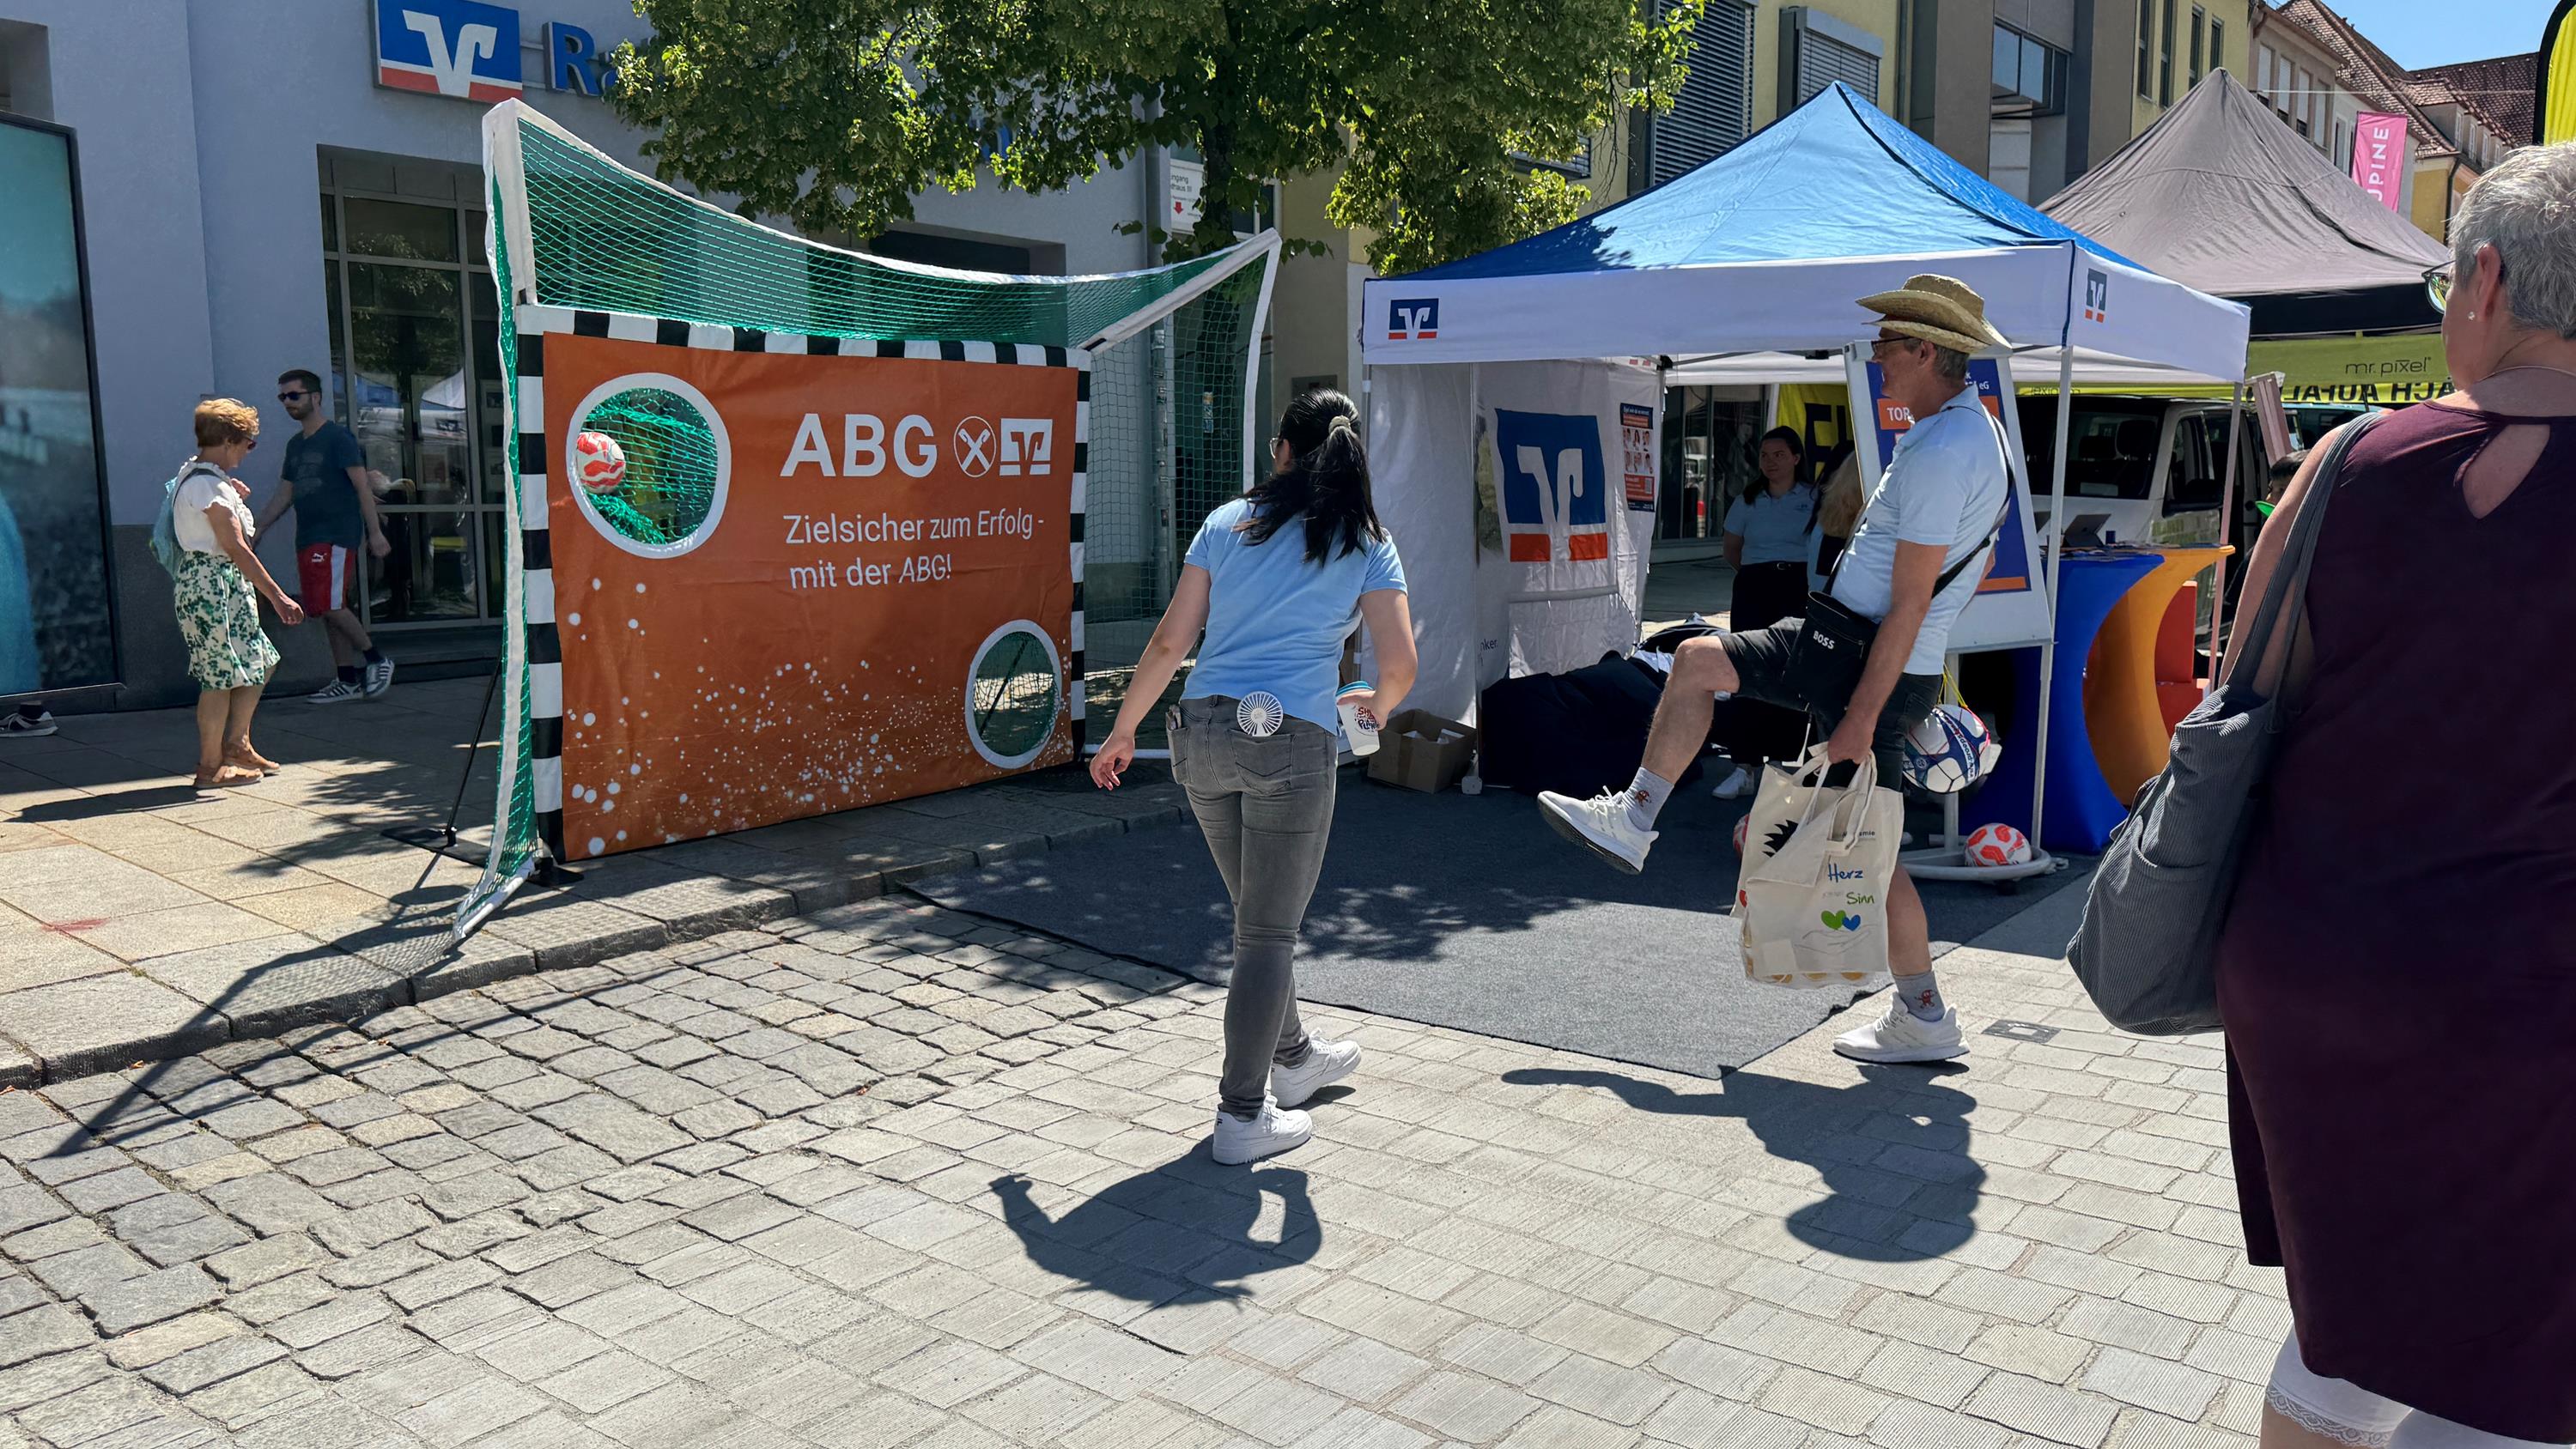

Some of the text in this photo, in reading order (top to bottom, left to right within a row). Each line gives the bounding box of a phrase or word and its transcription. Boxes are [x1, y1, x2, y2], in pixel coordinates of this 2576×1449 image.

[2367, 127, 2390, 201] UPINE
[2345, 357, 2429, 377] mr. pixel
[1886, 406, 1912, 422] TOR
[780, 413, 939, 478] ABG
[783, 512, 924, 544] Zielsicher
[930, 515, 971, 539] zum
[977, 507, 1033, 540] Erfolg
[789, 553, 952, 590] mit der ABG!
[1813, 630, 1835, 650] BOSS
[1827, 863, 1863, 883] Herz
[1846, 891, 1875, 906] Sinn
